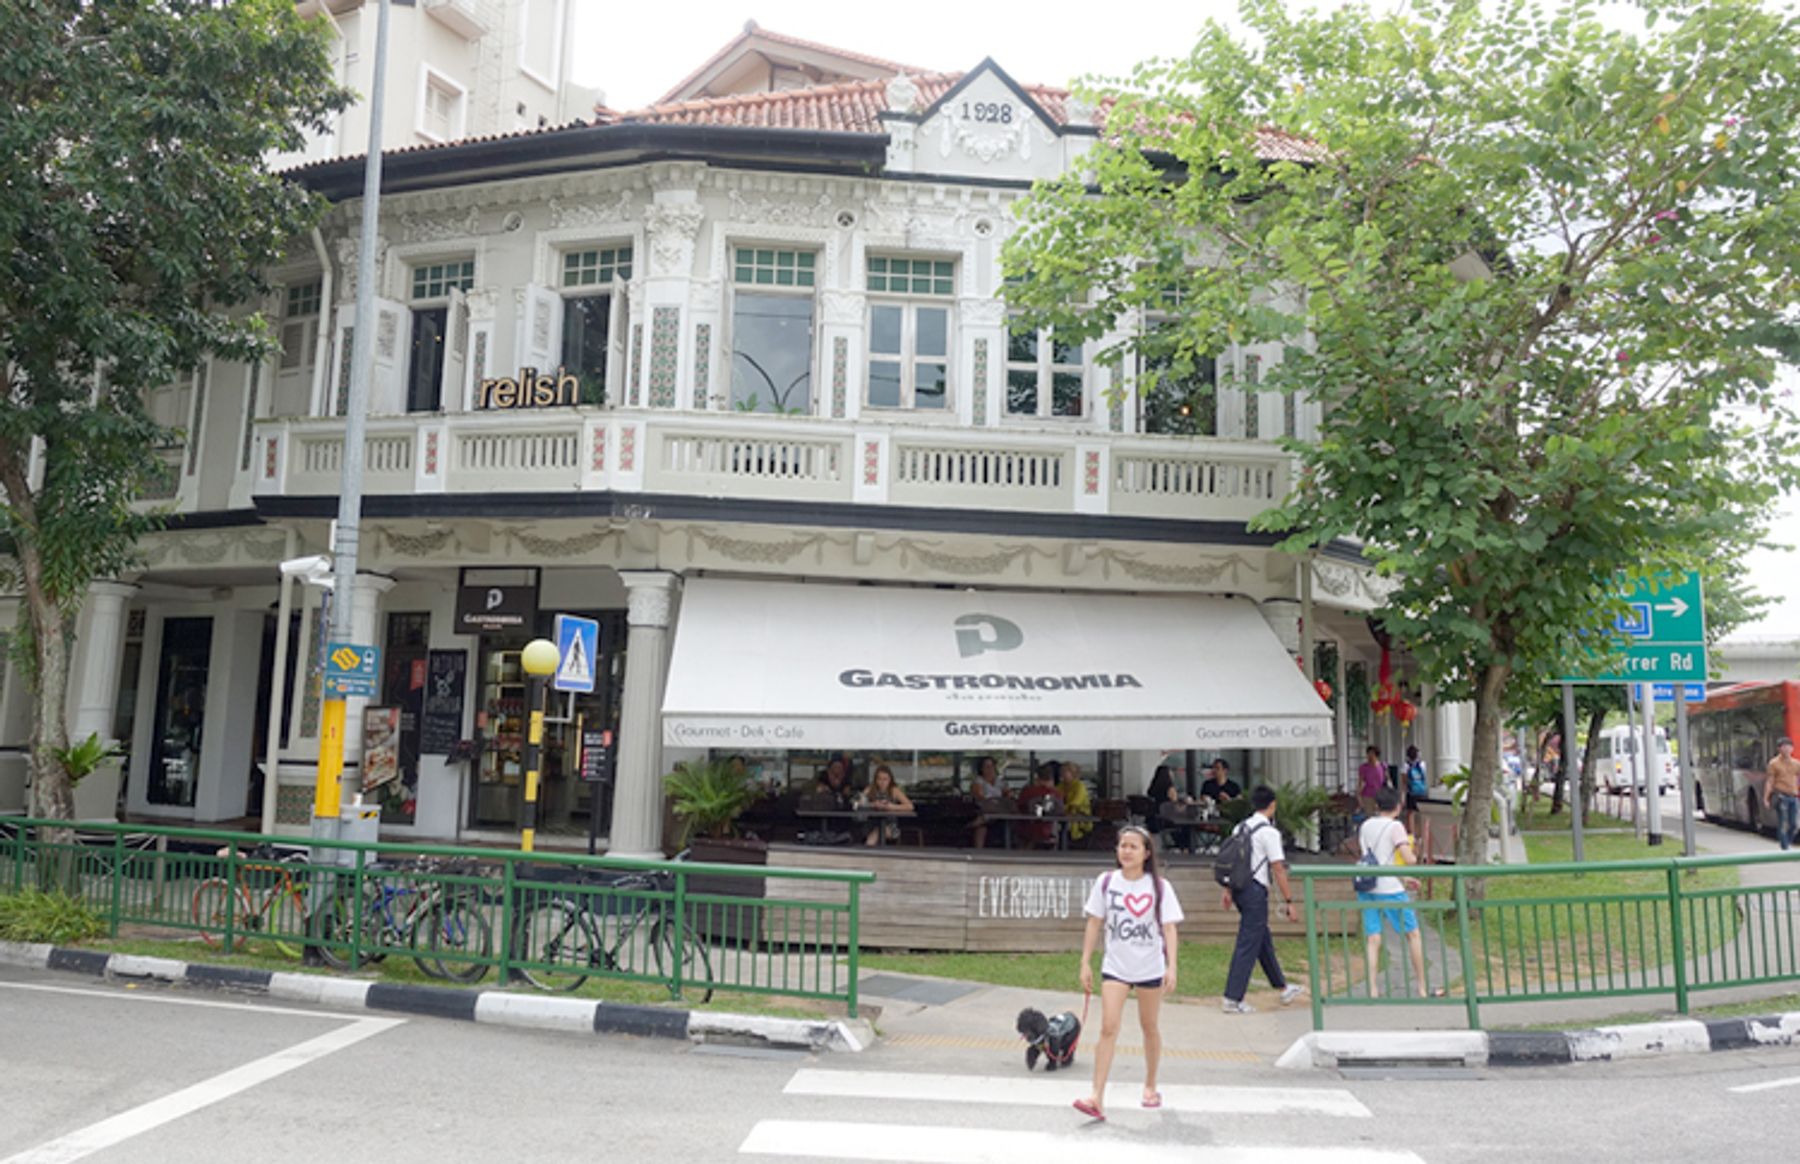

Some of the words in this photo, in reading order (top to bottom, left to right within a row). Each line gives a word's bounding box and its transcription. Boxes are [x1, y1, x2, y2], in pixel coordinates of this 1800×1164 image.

[962, 101, 1012, 123] 1928
[480, 366, 579, 409] relish
[1605, 655, 1660, 672] rrer
[1670, 652, 1694, 671] Rd
[838, 669, 1143, 690] GASTRONOMIA
[674, 723, 731, 738] Gourmet
[740, 725, 764, 738] Deli
[944, 722, 1062, 737] GASTRONOMIA
[1196, 727, 1249, 739] Gourmet
[1259, 725, 1281, 738] Deli
[979, 876, 1069, 918] EVERYDAY
